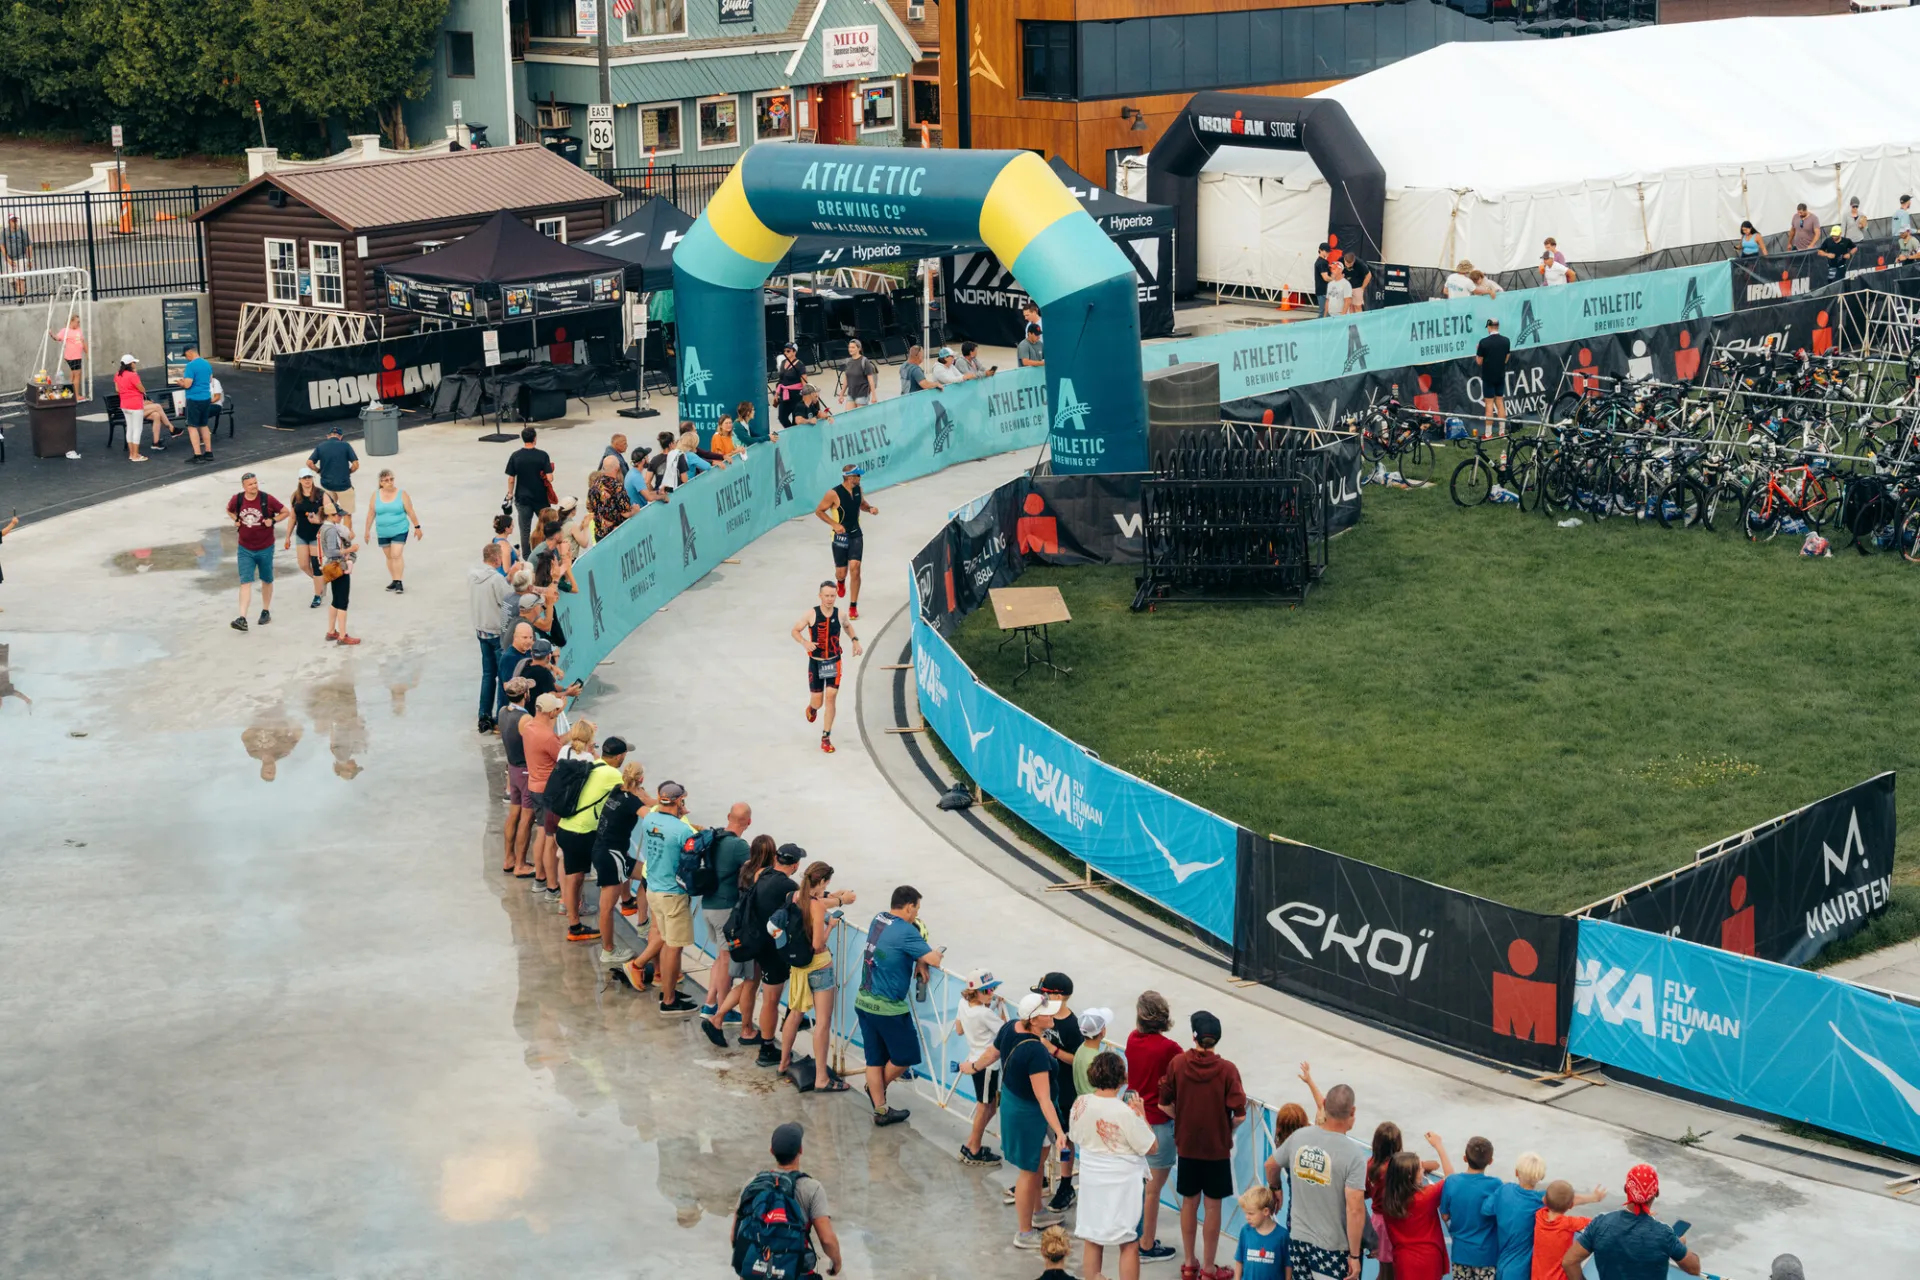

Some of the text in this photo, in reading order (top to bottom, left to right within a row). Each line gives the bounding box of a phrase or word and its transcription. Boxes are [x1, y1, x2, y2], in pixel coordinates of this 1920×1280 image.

[834, 32, 869, 46] MITO
[592, 108, 609, 116] EAST
[1199, 110, 1296, 138] IRONMAN STORE
[594, 128, 610, 143] 86
[802, 162, 926, 196] ATHLETIC
[817, 200, 880, 218] BREWING
[812, 221, 928, 236] NON-ALCOHOLIC BREWS
[1110, 214, 1153, 230] Hyperice
[852, 243, 901, 260] Hyperice
[1747, 271, 1810, 302] IRONMAN
[1584, 291, 1642, 318] ATHLETIC
[1410, 315, 1472, 342] ATHLETIC
[1594, 319, 1624, 332] BREWING
[1233, 342, 1298, 372] ATHLETIC
[1421, 342, 1453, 356] BREWING
[308, 354, 442, 410] IRONMAN
[1246, 371, 1280, 386] BREWING
[1466, 366, 1546, 408] QTAR
[679, 402, 724, 419] THLETIC
[988, 384, 1048, 418] ATHLETIC
[1000, 416, 1030, 434] BREWING
[830, 424, 891, 462] ATHLETIC
[1054, 454, 1085, 467] BREWING
[716, 474, 752, 517] ATHLETIC
[621, 534, 656, 584] ATHLETIC
[974, 565, 994, 586] 1884
[1017, 744, 1073, 824] HOKA
[1073, 778, 1084, 796] FLY
[1073, 797, 1102, 827] HUMAN
[1073, 814, 1084, 831] FLY
[1806, 874, 1891, 939] MAURTEN
[1574, 957, 1656, 1037] KA
[1664, 979, 1696, 1004] FLY
[1663, 1000, 1740, 1039] HUMAN
[1661, 1022, 1694, 1045] FLY
[1300, 1158, 1323, 1171] STATE
